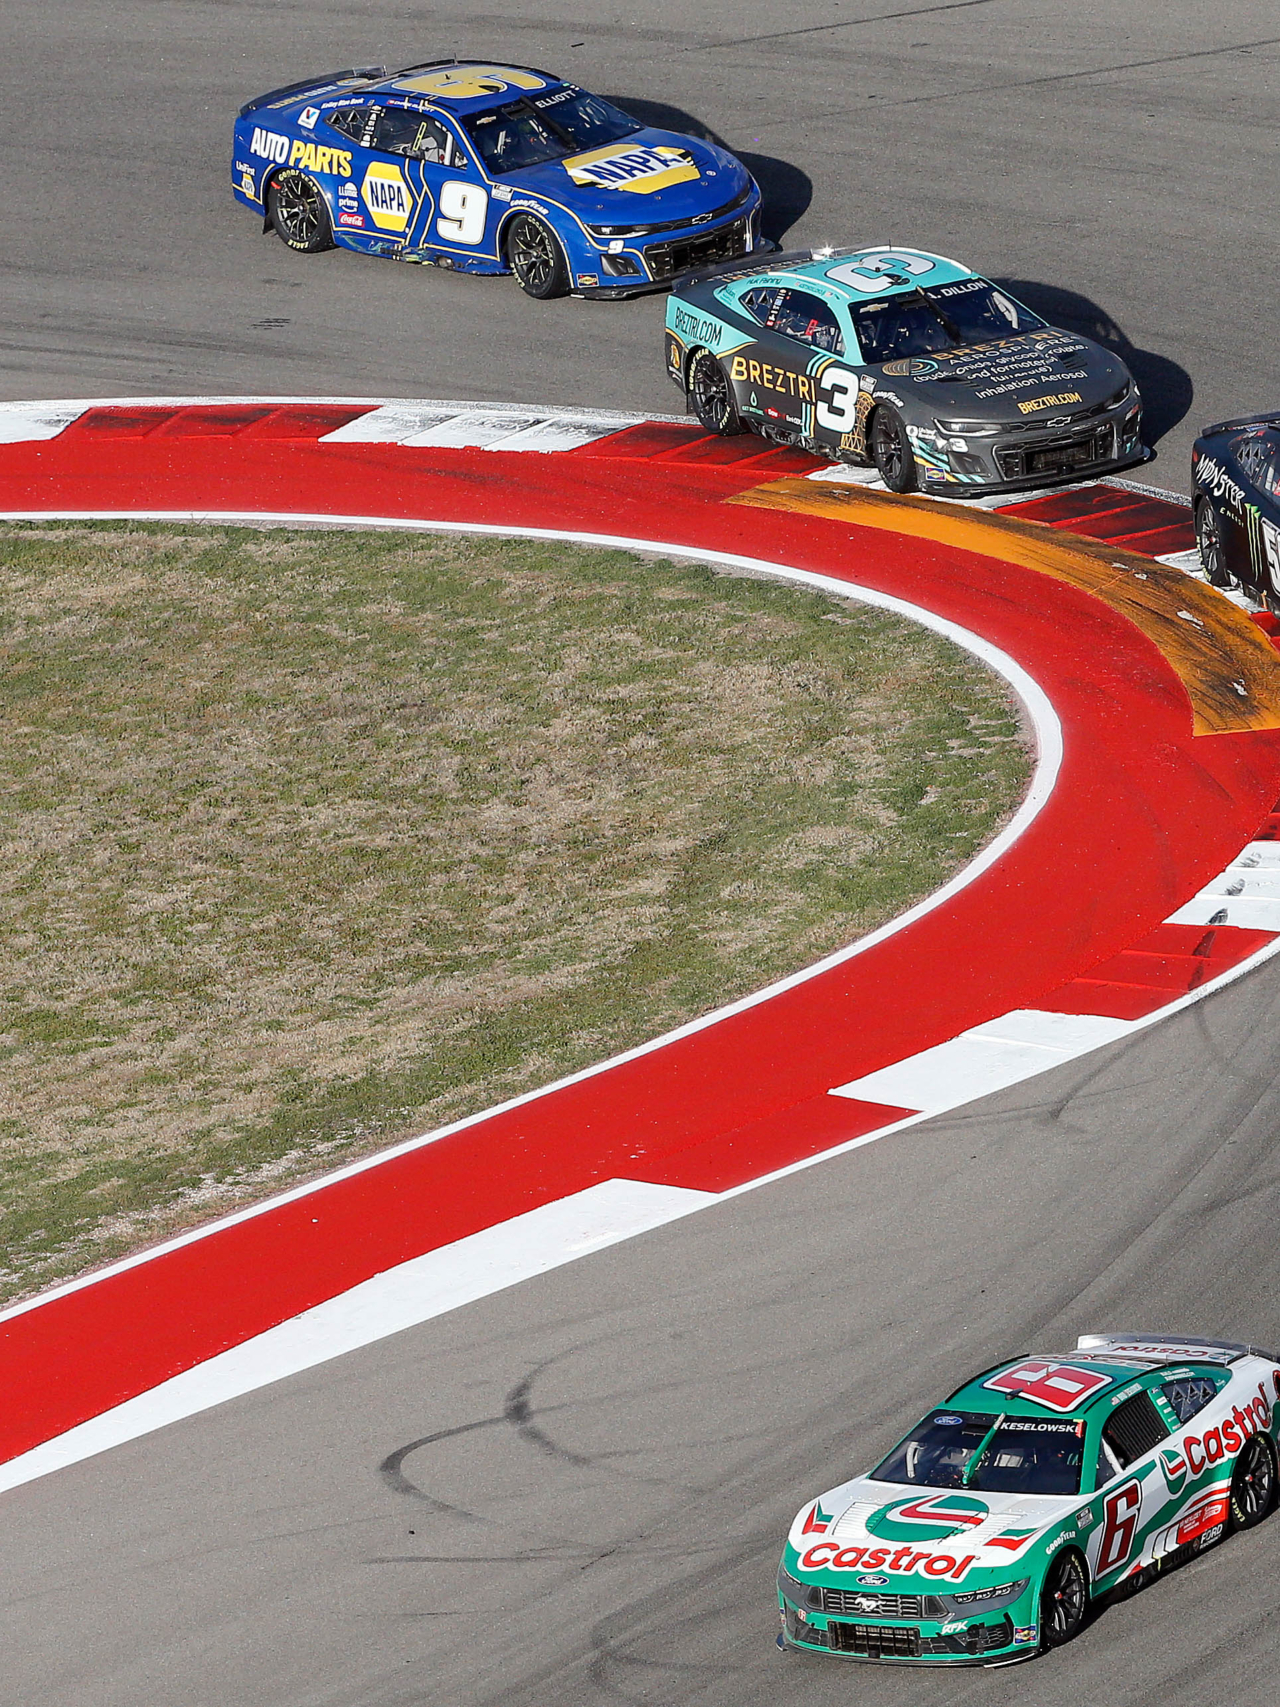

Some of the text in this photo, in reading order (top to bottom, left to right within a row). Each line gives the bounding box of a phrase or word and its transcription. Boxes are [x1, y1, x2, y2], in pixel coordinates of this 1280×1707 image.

[535, 90, 577, 109] ELLIOTT
[250, 127, 353, 178] AUTO PARTS
[581, 149, 682, 184] NAPA
[338, 198, 358, 208] prime
[369, 179, 406, 214] NAPA
[437, 181, 488, 245] 9
[608, 240, 624, 254] 9
[940, 280, 989, 297] DILLON
[675, 306, 723, 346] BREZTRI.COM
[931, 330, 1063, 360] BREZTRI
[730, 356, 816, 403] BREZTRI
[975, 369, 1088, 400] Inhalation Aerosol
[816, 367, 859, 433] 3
[1017, 392, 1083, 415] BREZTRI.COM
[949, 437, 969, 453] 3
[1184, 1381, 1272, 1475] Castrol
[1045, 1530, 1076, 1555] GOODYEAR
[1095, 1482, 1141, 1577] 6
[1200, 1523, 1223, 1544] FORD
[802, 1541, 975, 1578] Castrol
[859, 1575, 887, 1585] Ford
[941, 1620, 968, 1635] RFK
